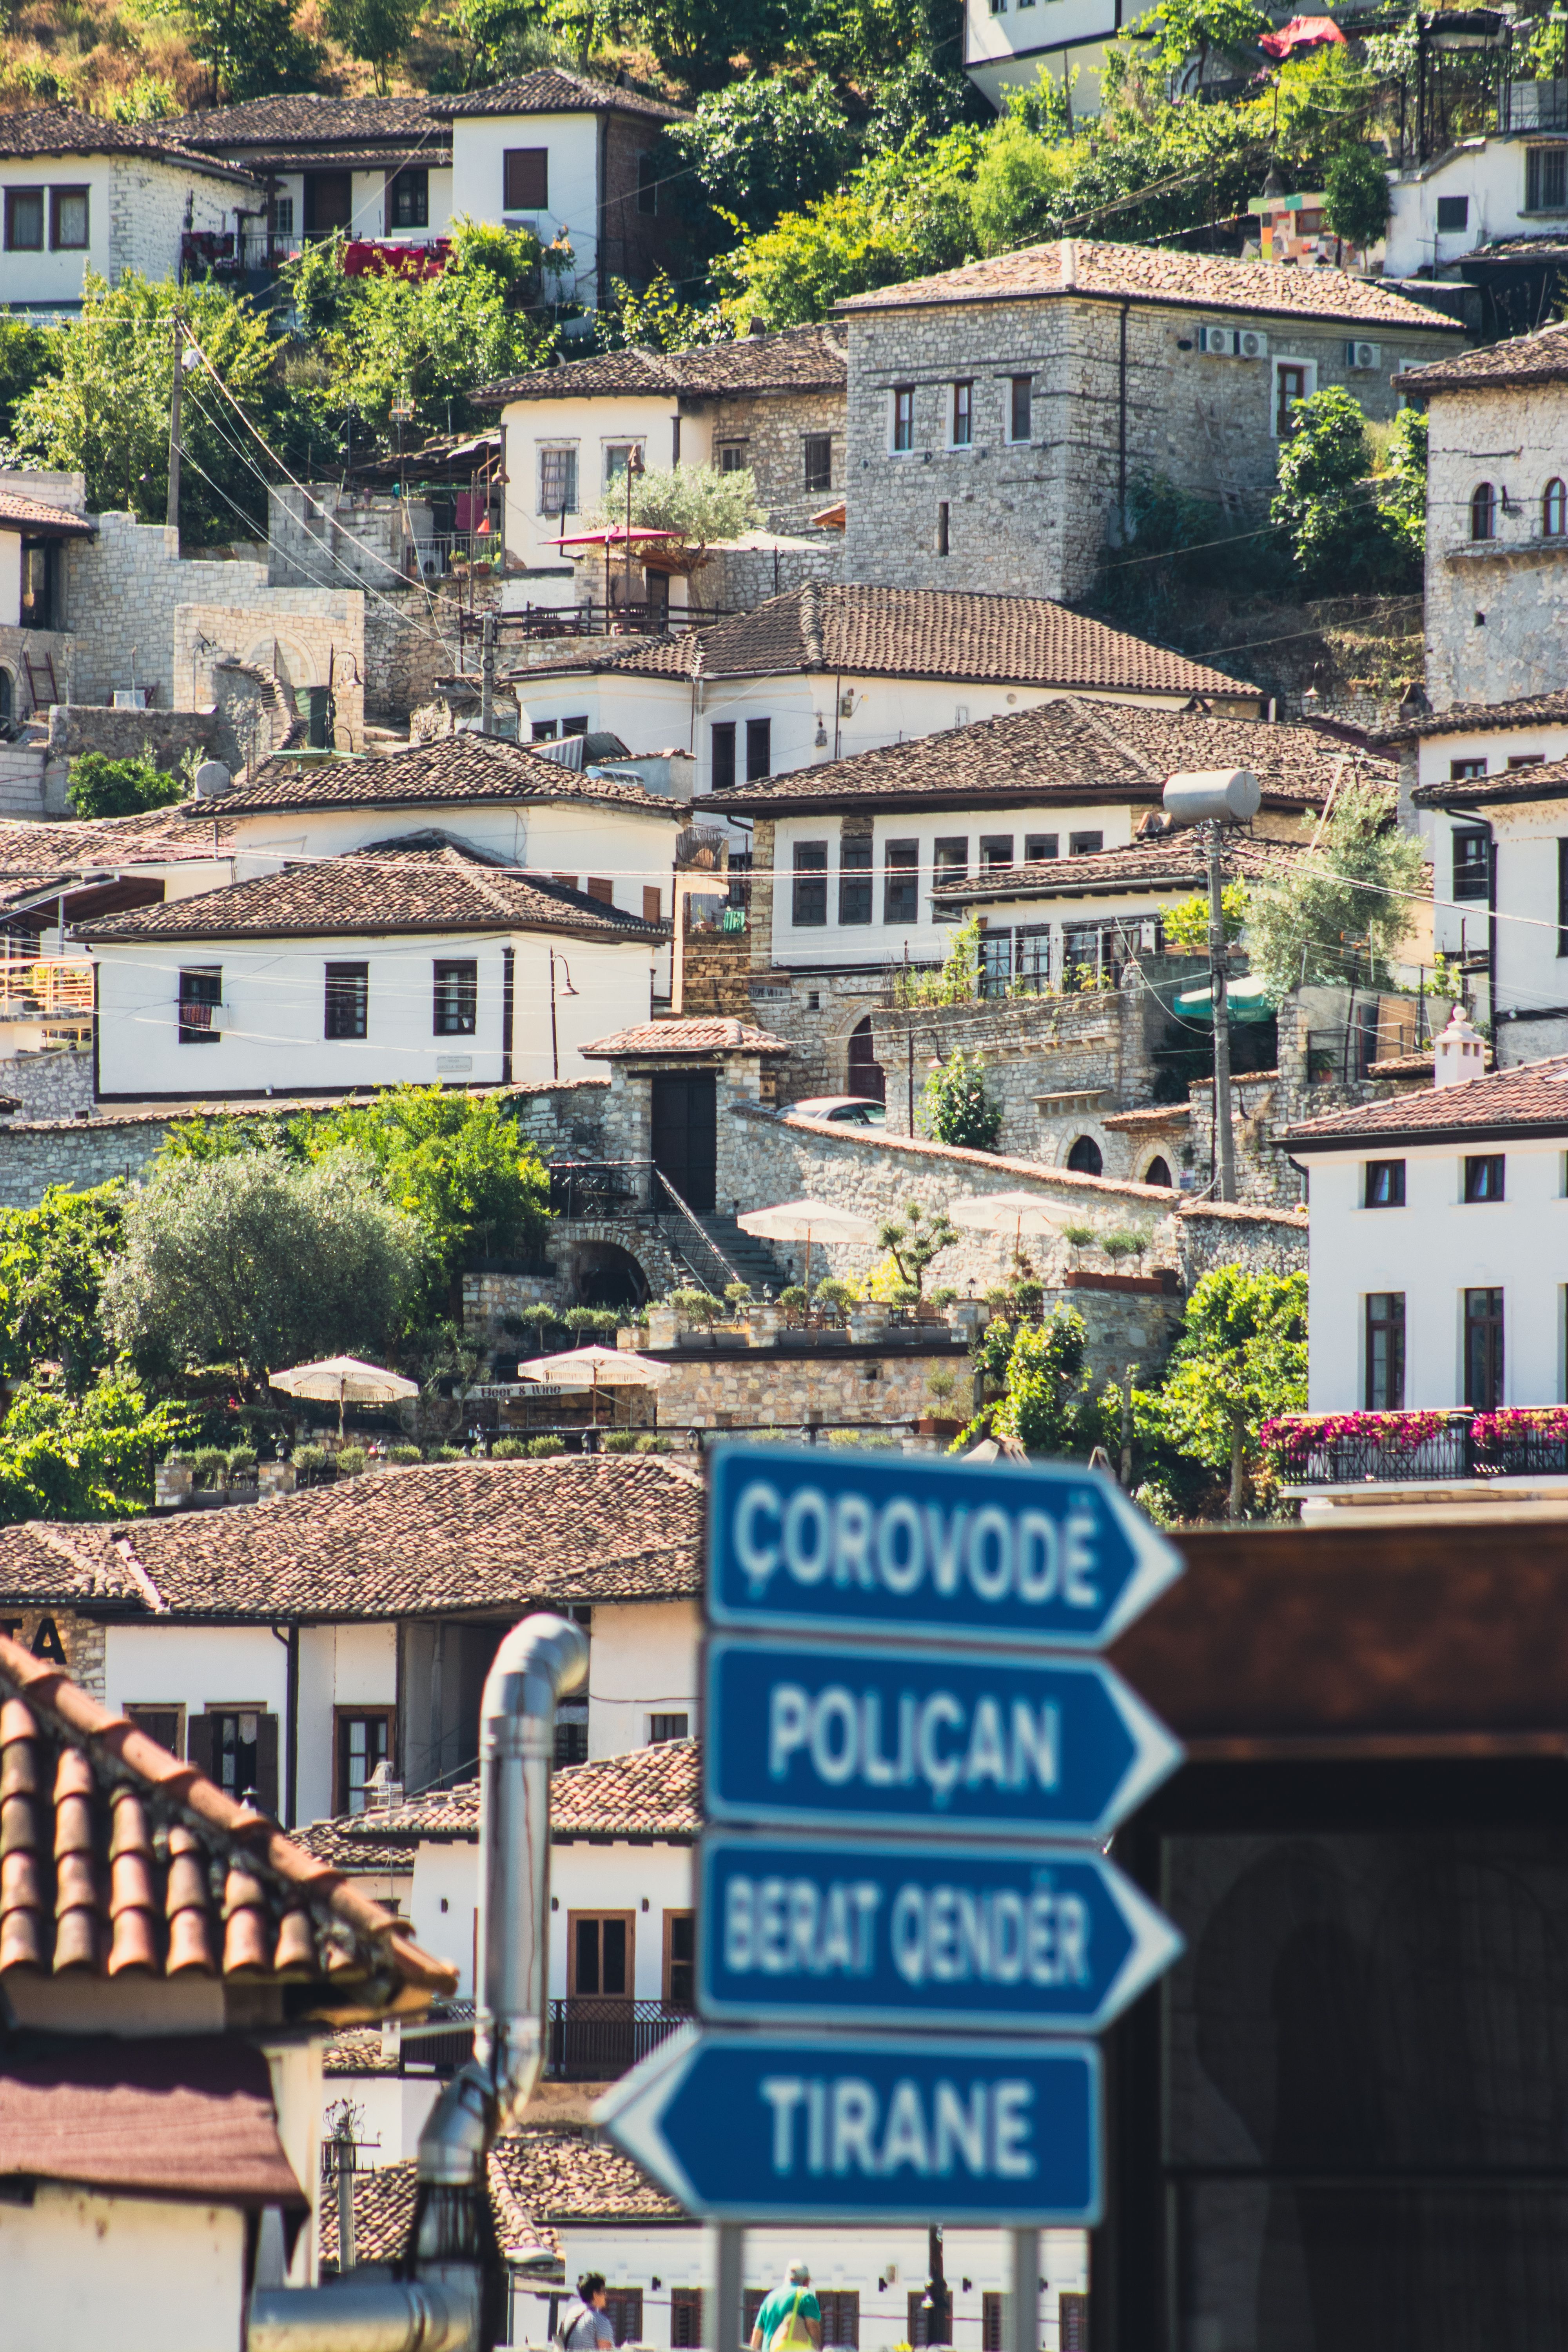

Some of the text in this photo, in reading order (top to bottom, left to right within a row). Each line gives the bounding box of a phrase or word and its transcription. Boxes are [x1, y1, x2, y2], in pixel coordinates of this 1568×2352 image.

[481, 1385, 561, 1398] Beer & Wine
[732, 1481, 1098, 1608] ÇOROVODË
[768, 1682, 1060, 1809] POLIÇAN
[724, 1868, 1091, 1989] BERAT QENDËR
[759, 2076, 1036, 2180] TIRANE
